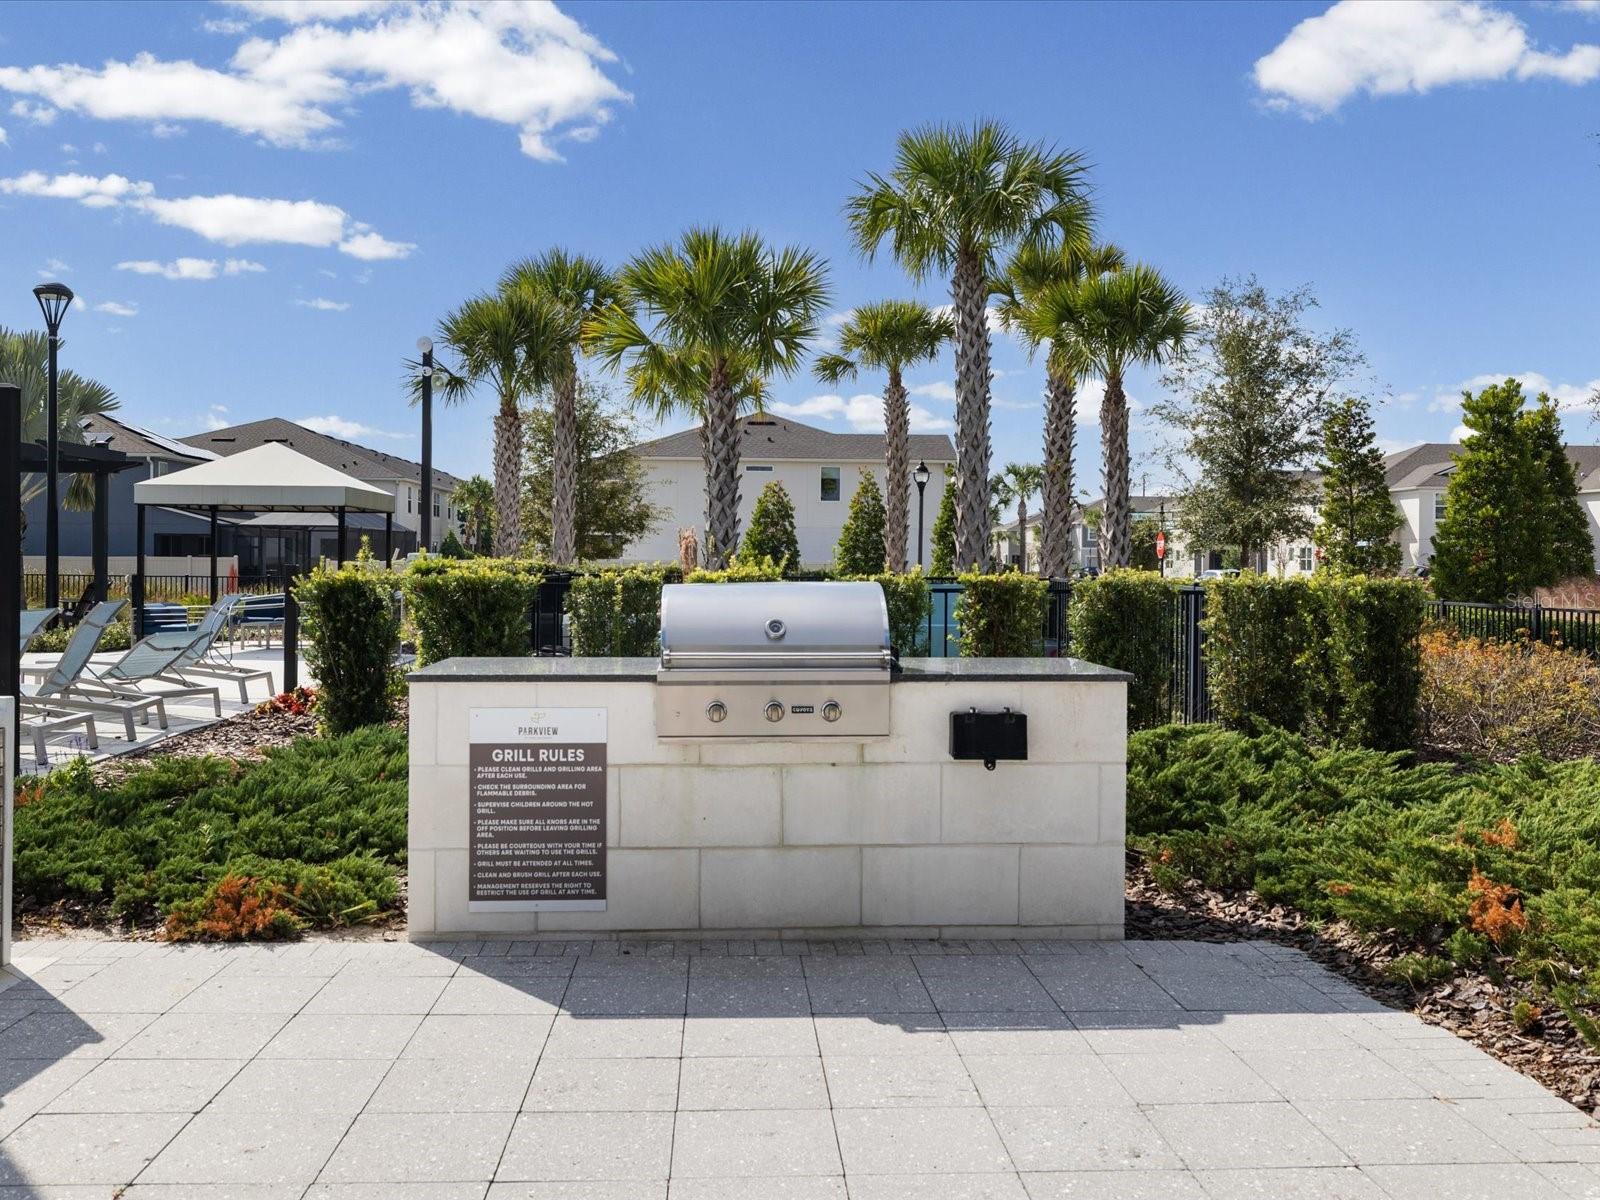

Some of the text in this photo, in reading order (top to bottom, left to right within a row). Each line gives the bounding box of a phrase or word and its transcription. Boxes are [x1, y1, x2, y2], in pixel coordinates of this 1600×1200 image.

[518, 726, 559, 736] PARKVIEW
[492, 749, 585, 761] GRILL RULES
